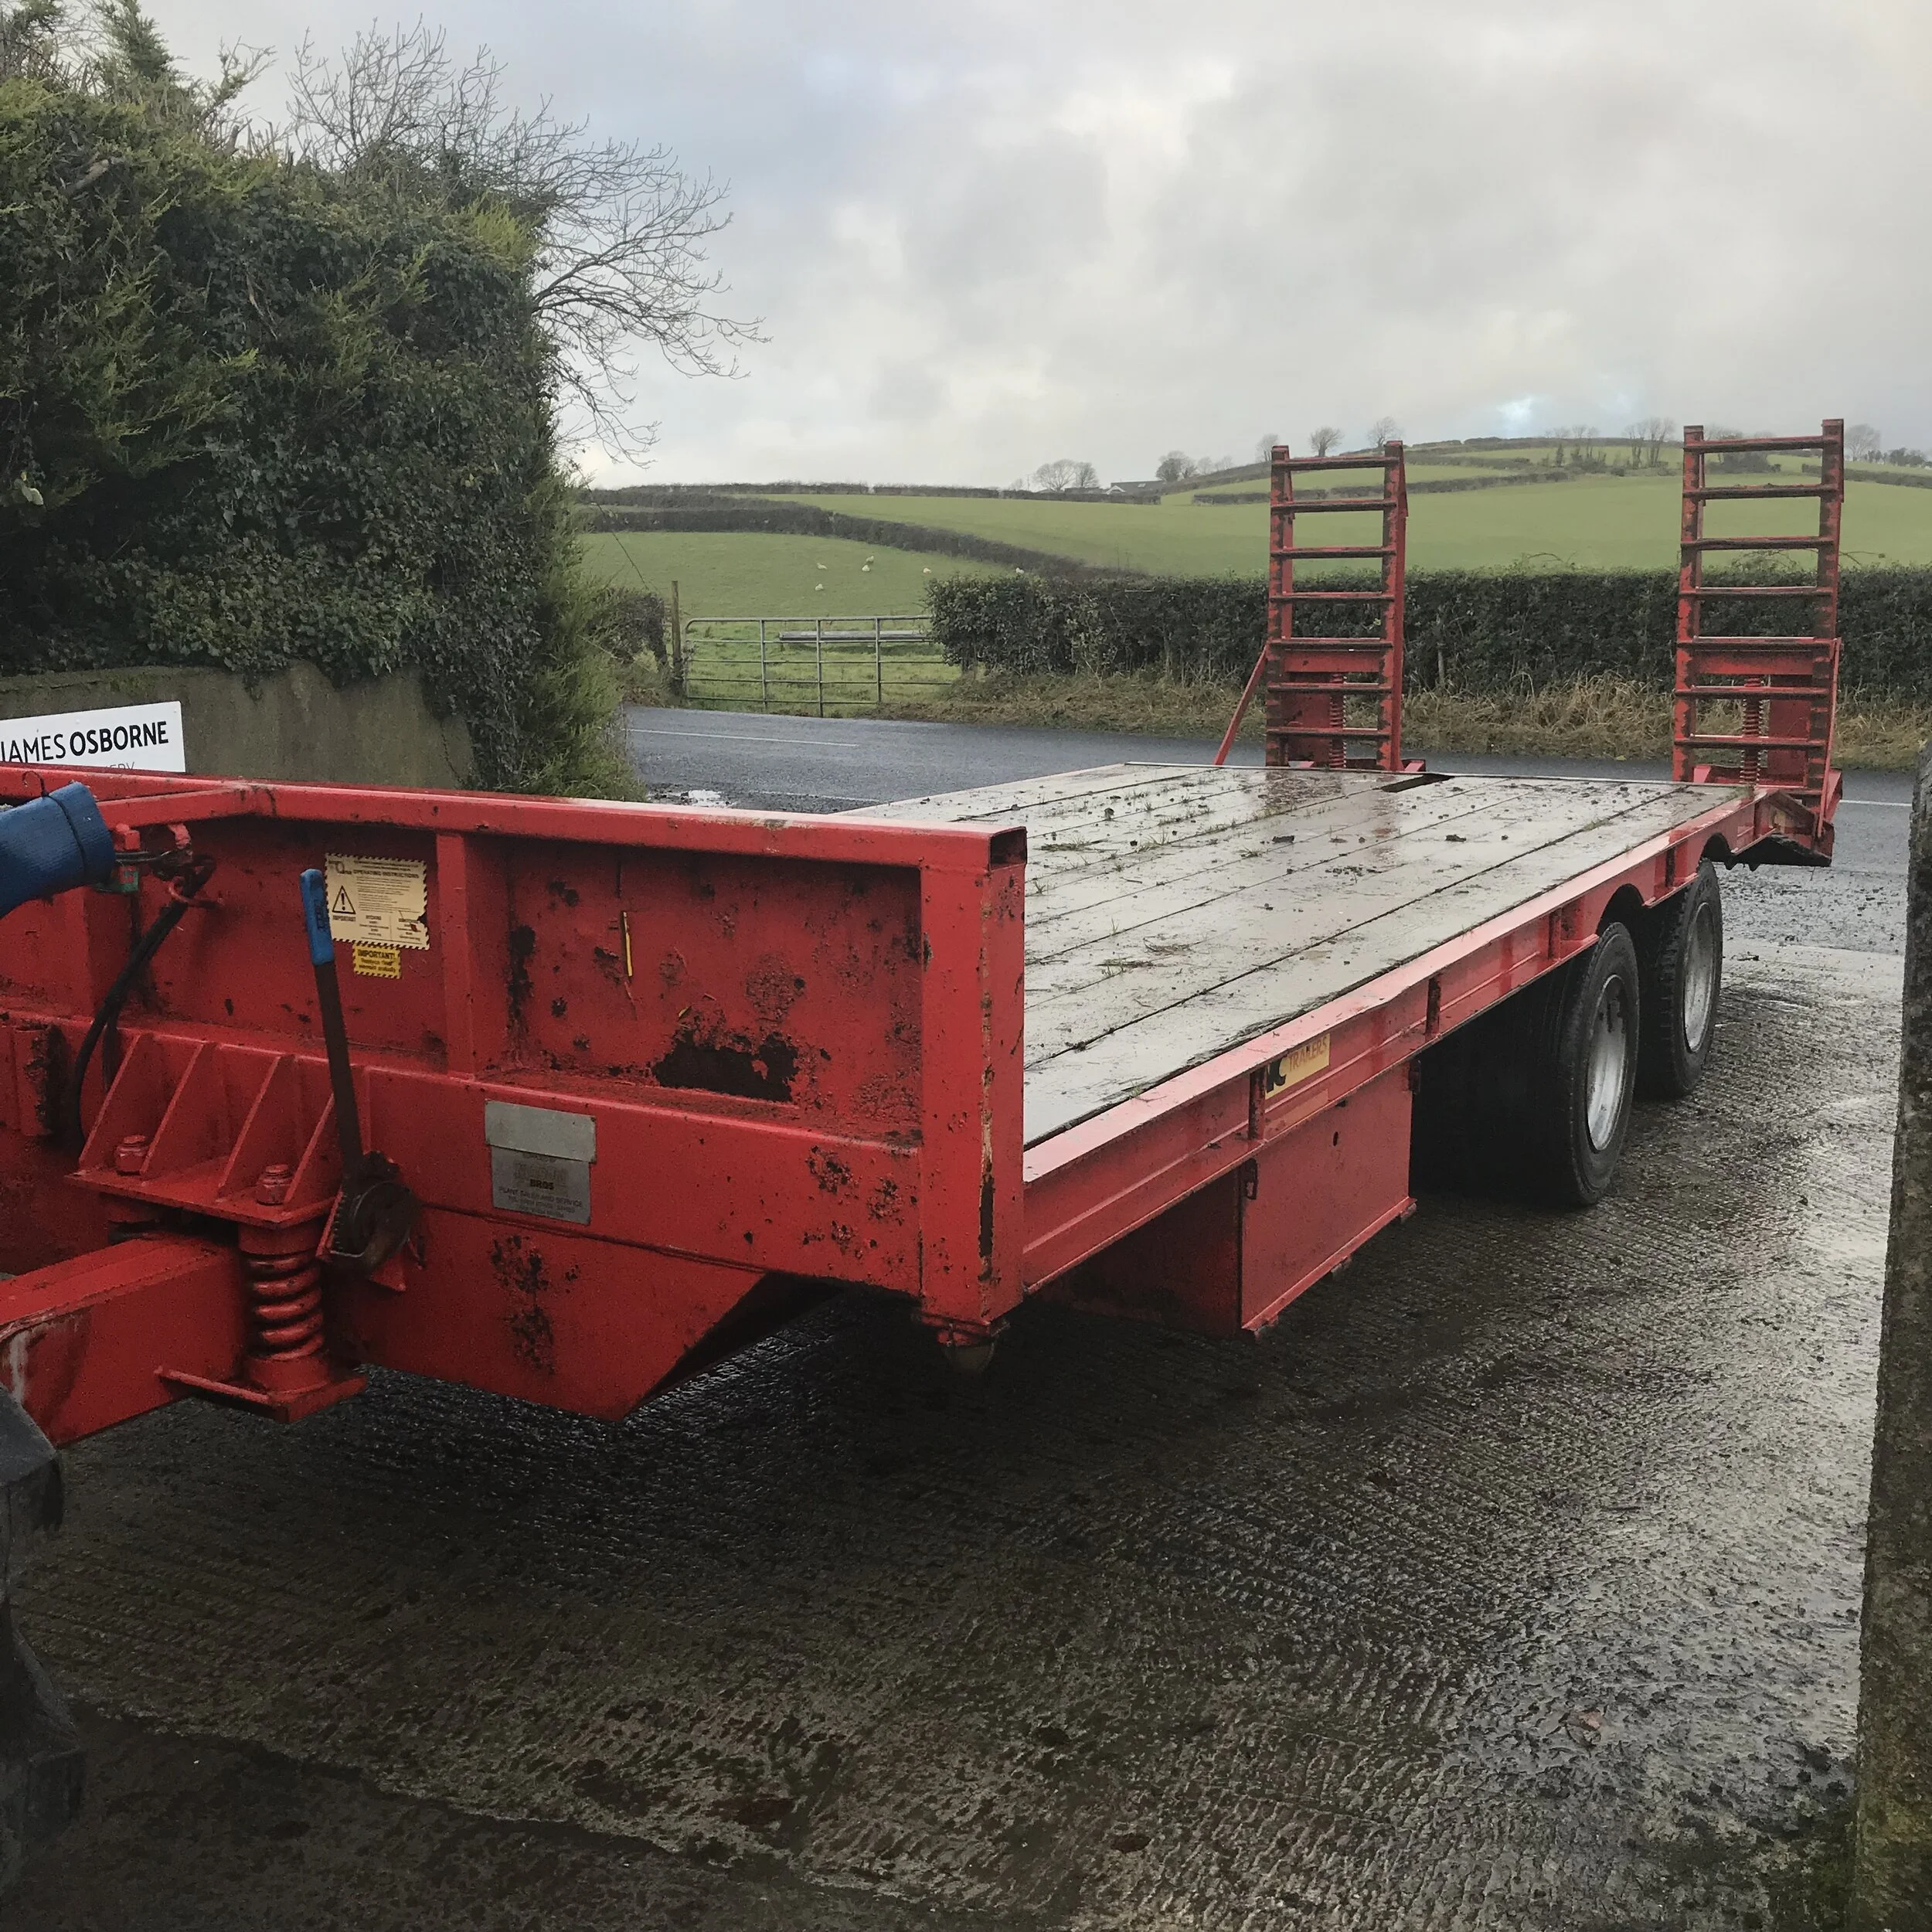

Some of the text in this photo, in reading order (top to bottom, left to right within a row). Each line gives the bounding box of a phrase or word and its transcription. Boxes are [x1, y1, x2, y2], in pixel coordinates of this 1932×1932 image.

[70, 721, 168, 757] OSBORNE
[1287, 1036, 1328, 1072] TRAILERS
[529, 1179, 554, 1190] BROS
